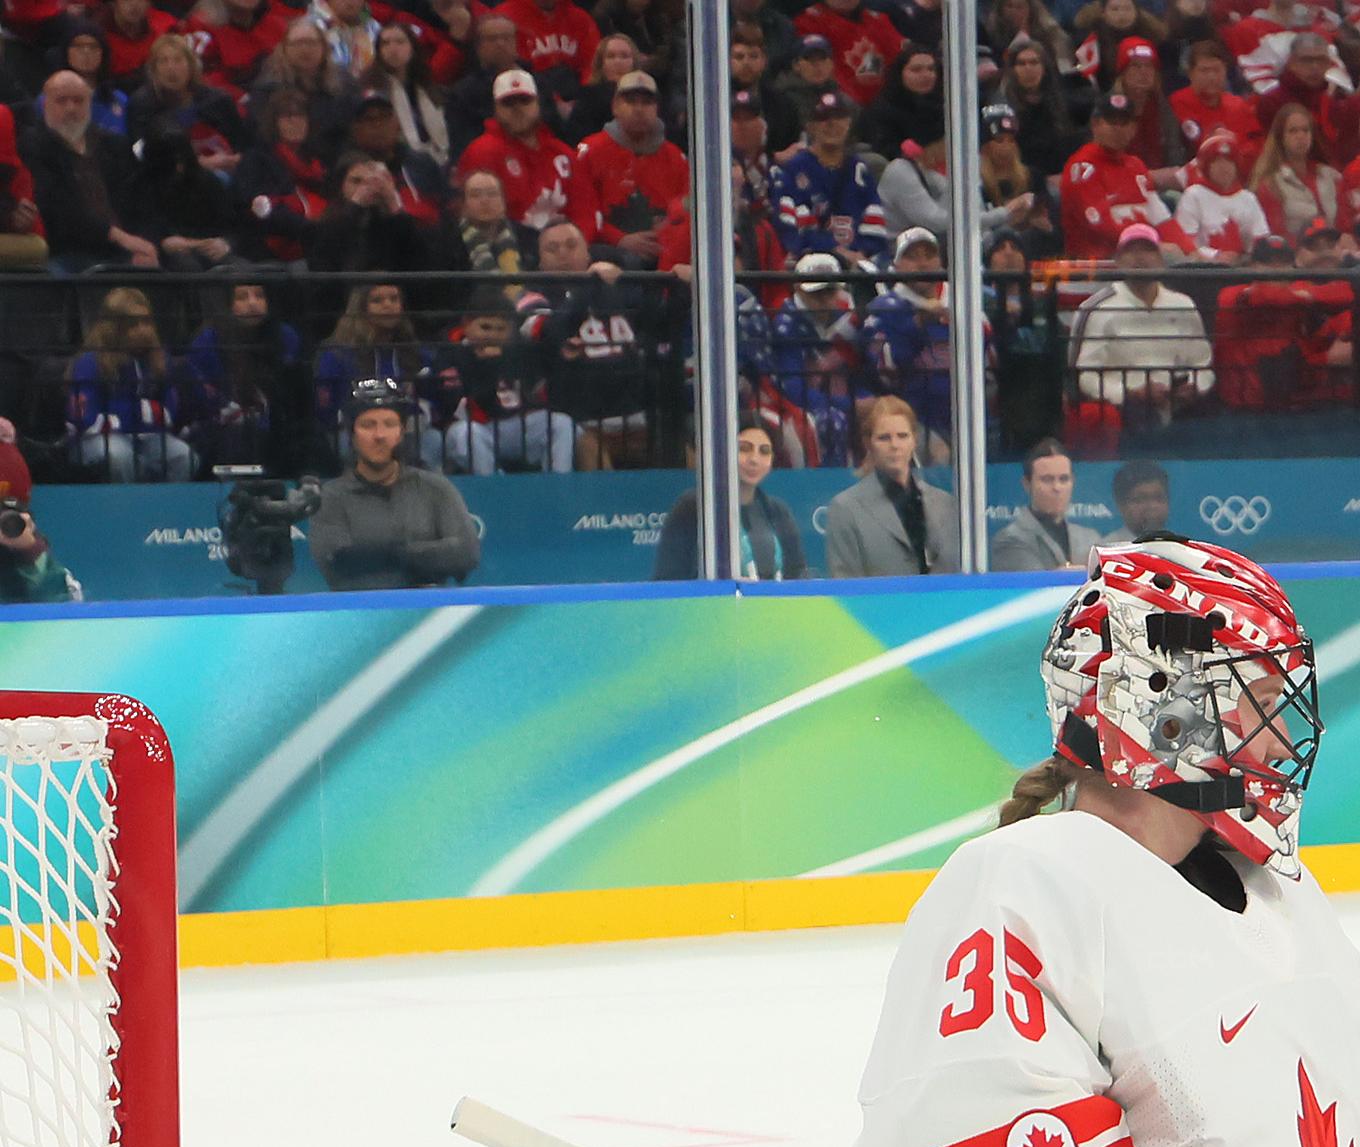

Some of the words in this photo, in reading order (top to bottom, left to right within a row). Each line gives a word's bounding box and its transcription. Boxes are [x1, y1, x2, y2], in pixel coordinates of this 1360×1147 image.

[573, 514, 645, 531] MILANO
[145, 526, 222, 544] MILANO
[938, 926, 1049, 1043] 35
